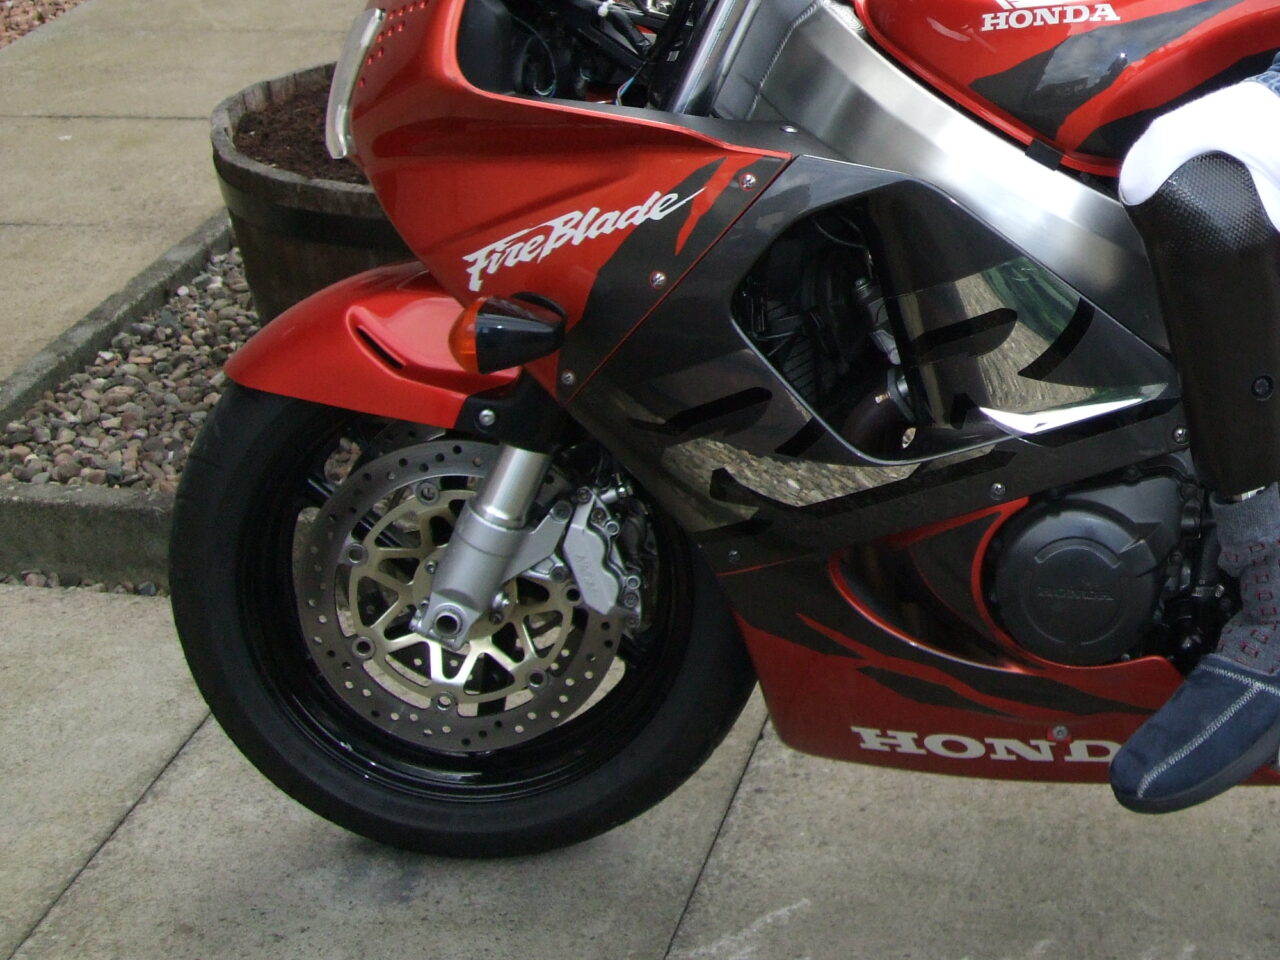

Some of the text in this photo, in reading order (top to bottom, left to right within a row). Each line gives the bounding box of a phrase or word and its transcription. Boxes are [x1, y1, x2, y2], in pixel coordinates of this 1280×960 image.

[981, 3, 1121, 32] HONDA
[462, 186, 707, 292] FireBlade
[850, 726, 1123, 763] HOND
